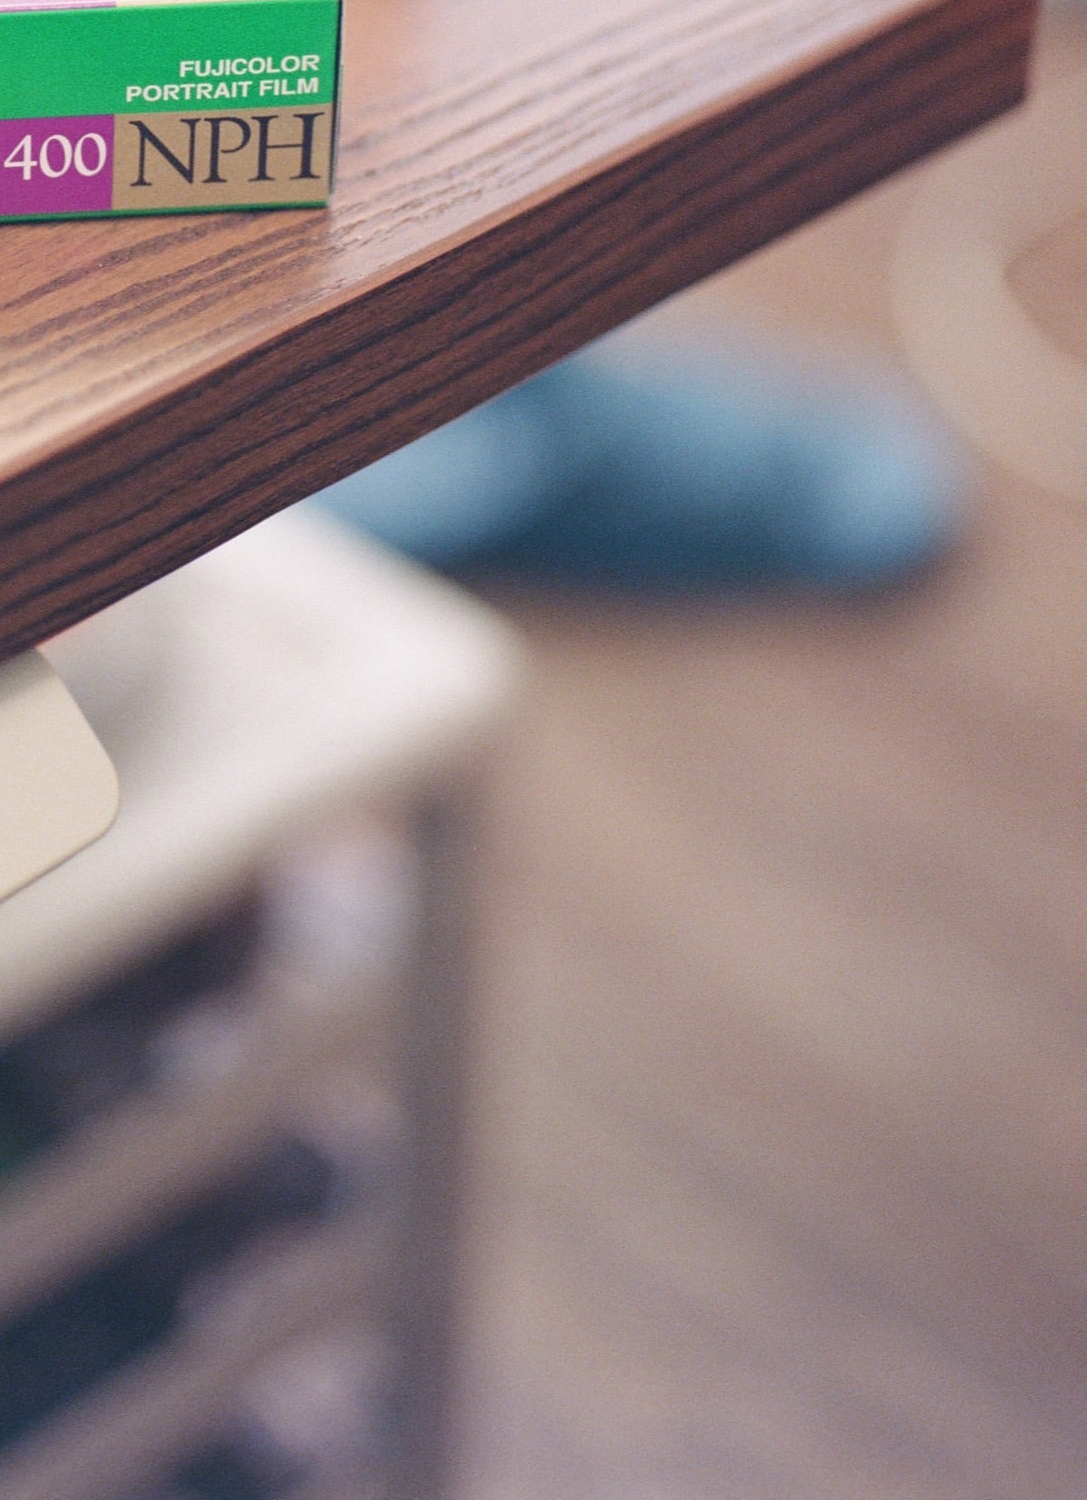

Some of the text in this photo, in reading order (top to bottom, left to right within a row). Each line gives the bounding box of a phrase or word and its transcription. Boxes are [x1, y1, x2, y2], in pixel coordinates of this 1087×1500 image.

[179, 55, 320, 78] FUJICOLOR
[125, 77, 319, 102] PORTRAIT FILM
[3, 132, 108, 181] 400
[129, 112, 326, 186] NPH
